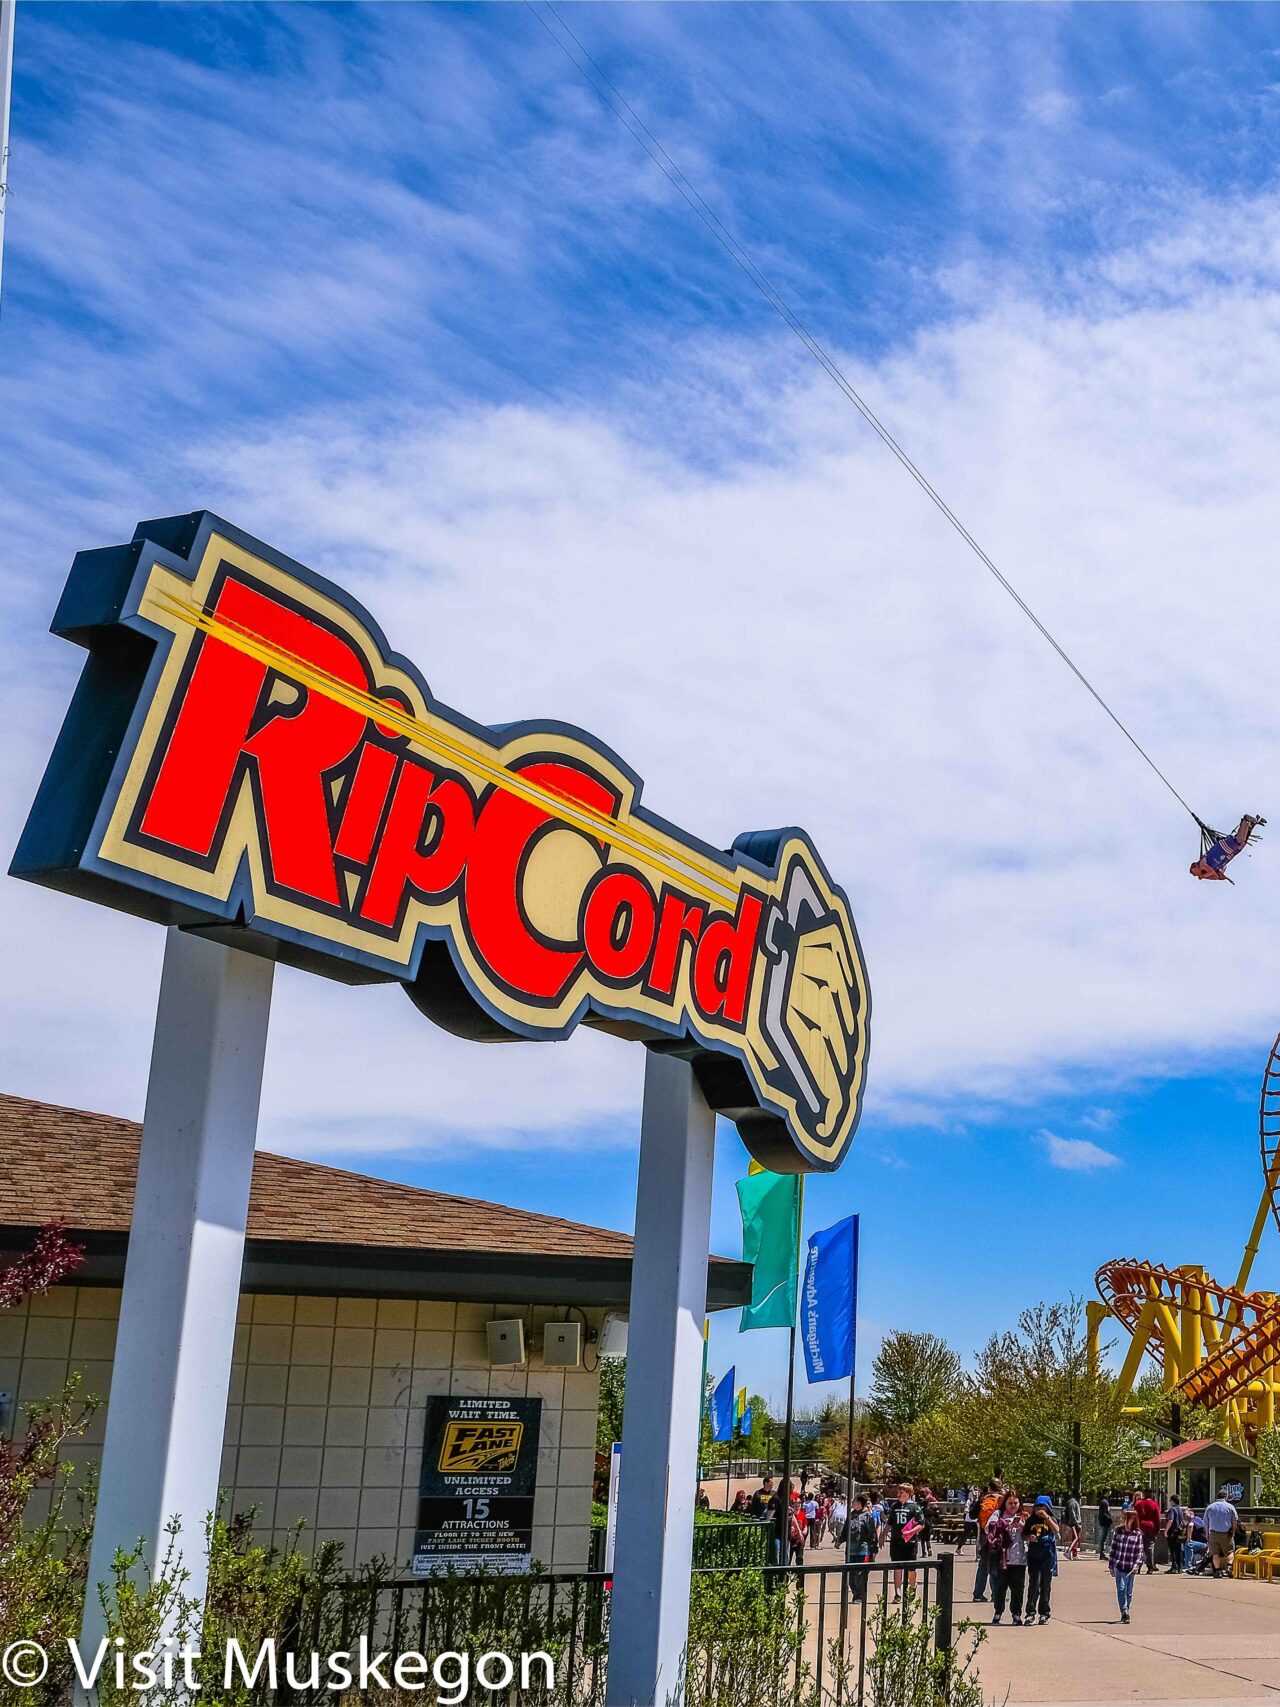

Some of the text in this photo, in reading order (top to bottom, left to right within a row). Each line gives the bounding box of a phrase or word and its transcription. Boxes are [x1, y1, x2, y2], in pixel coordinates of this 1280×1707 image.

[140, 576, 763, 1024] RipCord
[459, 1400, 511, 1409] LIMITED
[448, 1410, 520, 1420] WAIT TIME.
[453, 1427, 517, 1442] FAST
[448, 1439, 514, 1459] LANE
[444, 1476, 512, 1485] UNLIMITED
[455, 1487, 499, 1495] ACCESS
[463, 1498, 490, 1519] 15
[895, 1512, 907, 1524] 16
[442, 1520, 510, 1529] ATTRACTIONS
